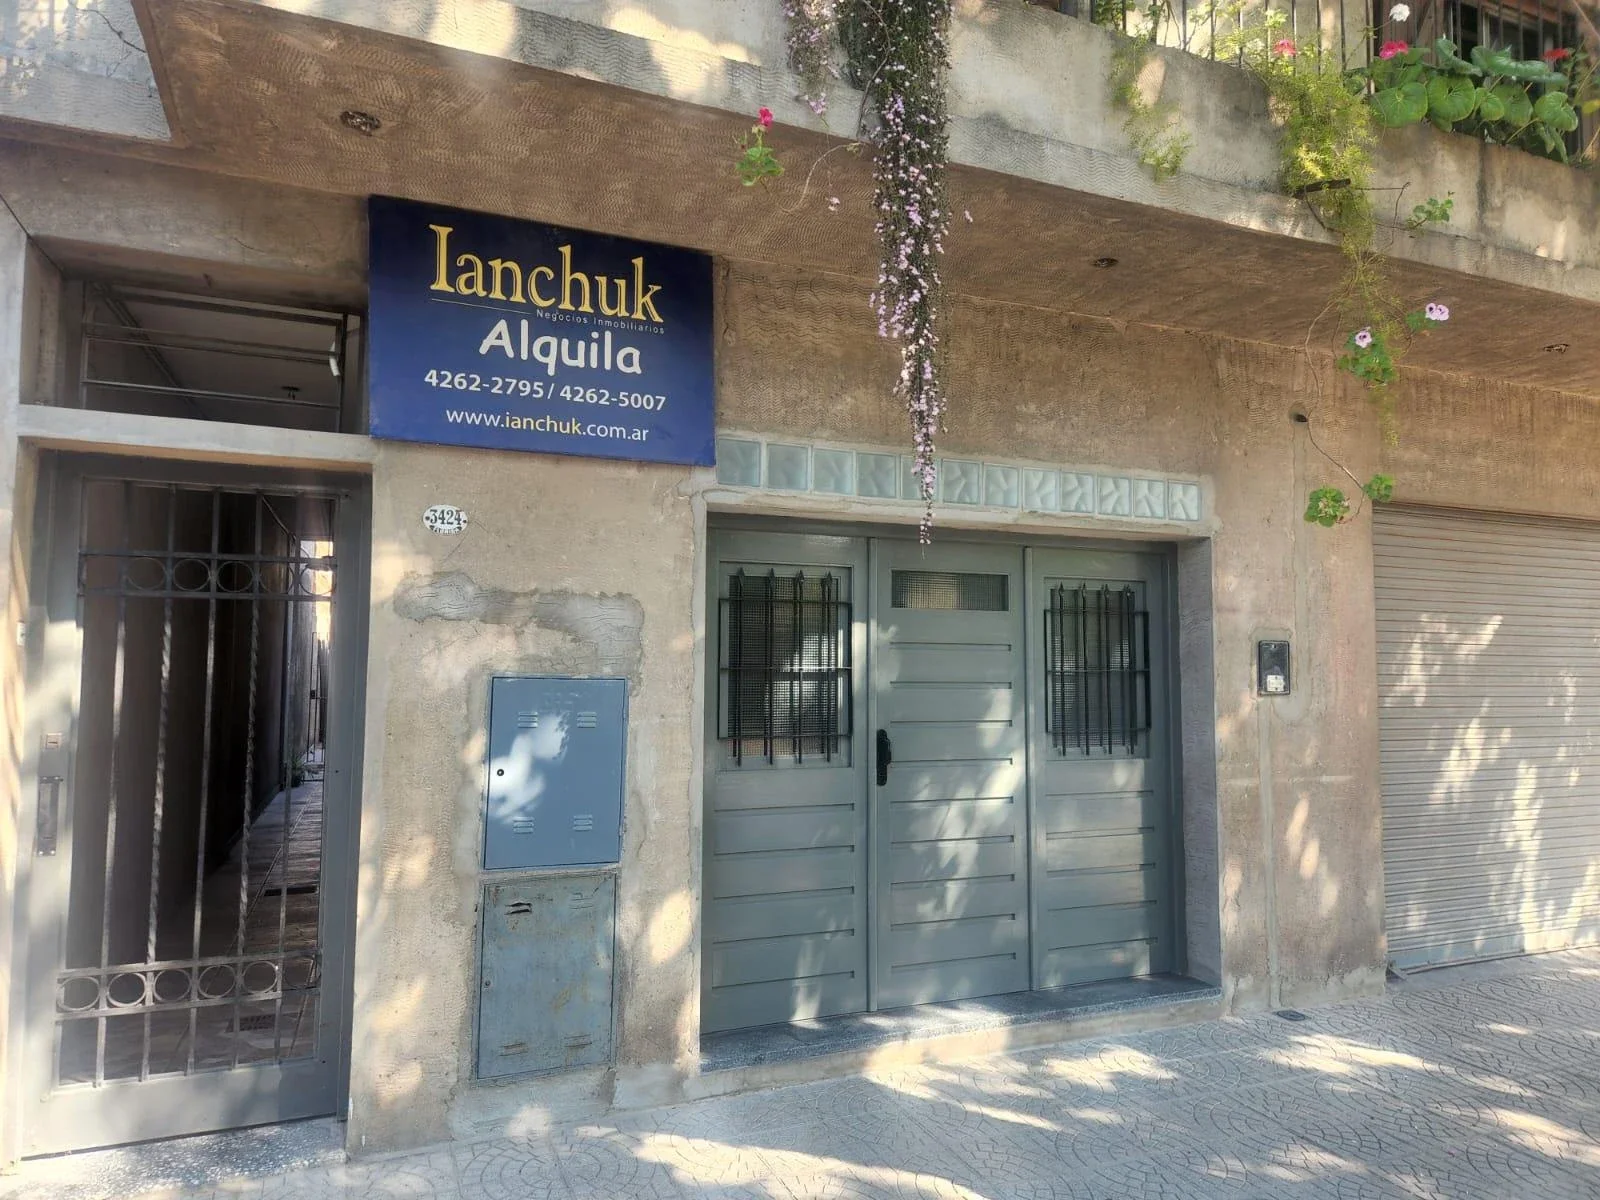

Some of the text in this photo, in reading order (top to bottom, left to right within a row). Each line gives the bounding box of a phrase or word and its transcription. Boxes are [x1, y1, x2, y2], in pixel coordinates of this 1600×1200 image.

[429, 224, 664, 323] Ianchuk
[536, 309, 665, 335] Negocios Inmobiliarios
[479, 318, 642, 376] Alquila
[424, 369, 544, 398] 4262-2795
[559, 385, 666, 411] 4262-5007
[446, 409, 649, 441] www.ianchuk.com.ar
[430, 509, 462, 525] 3424
